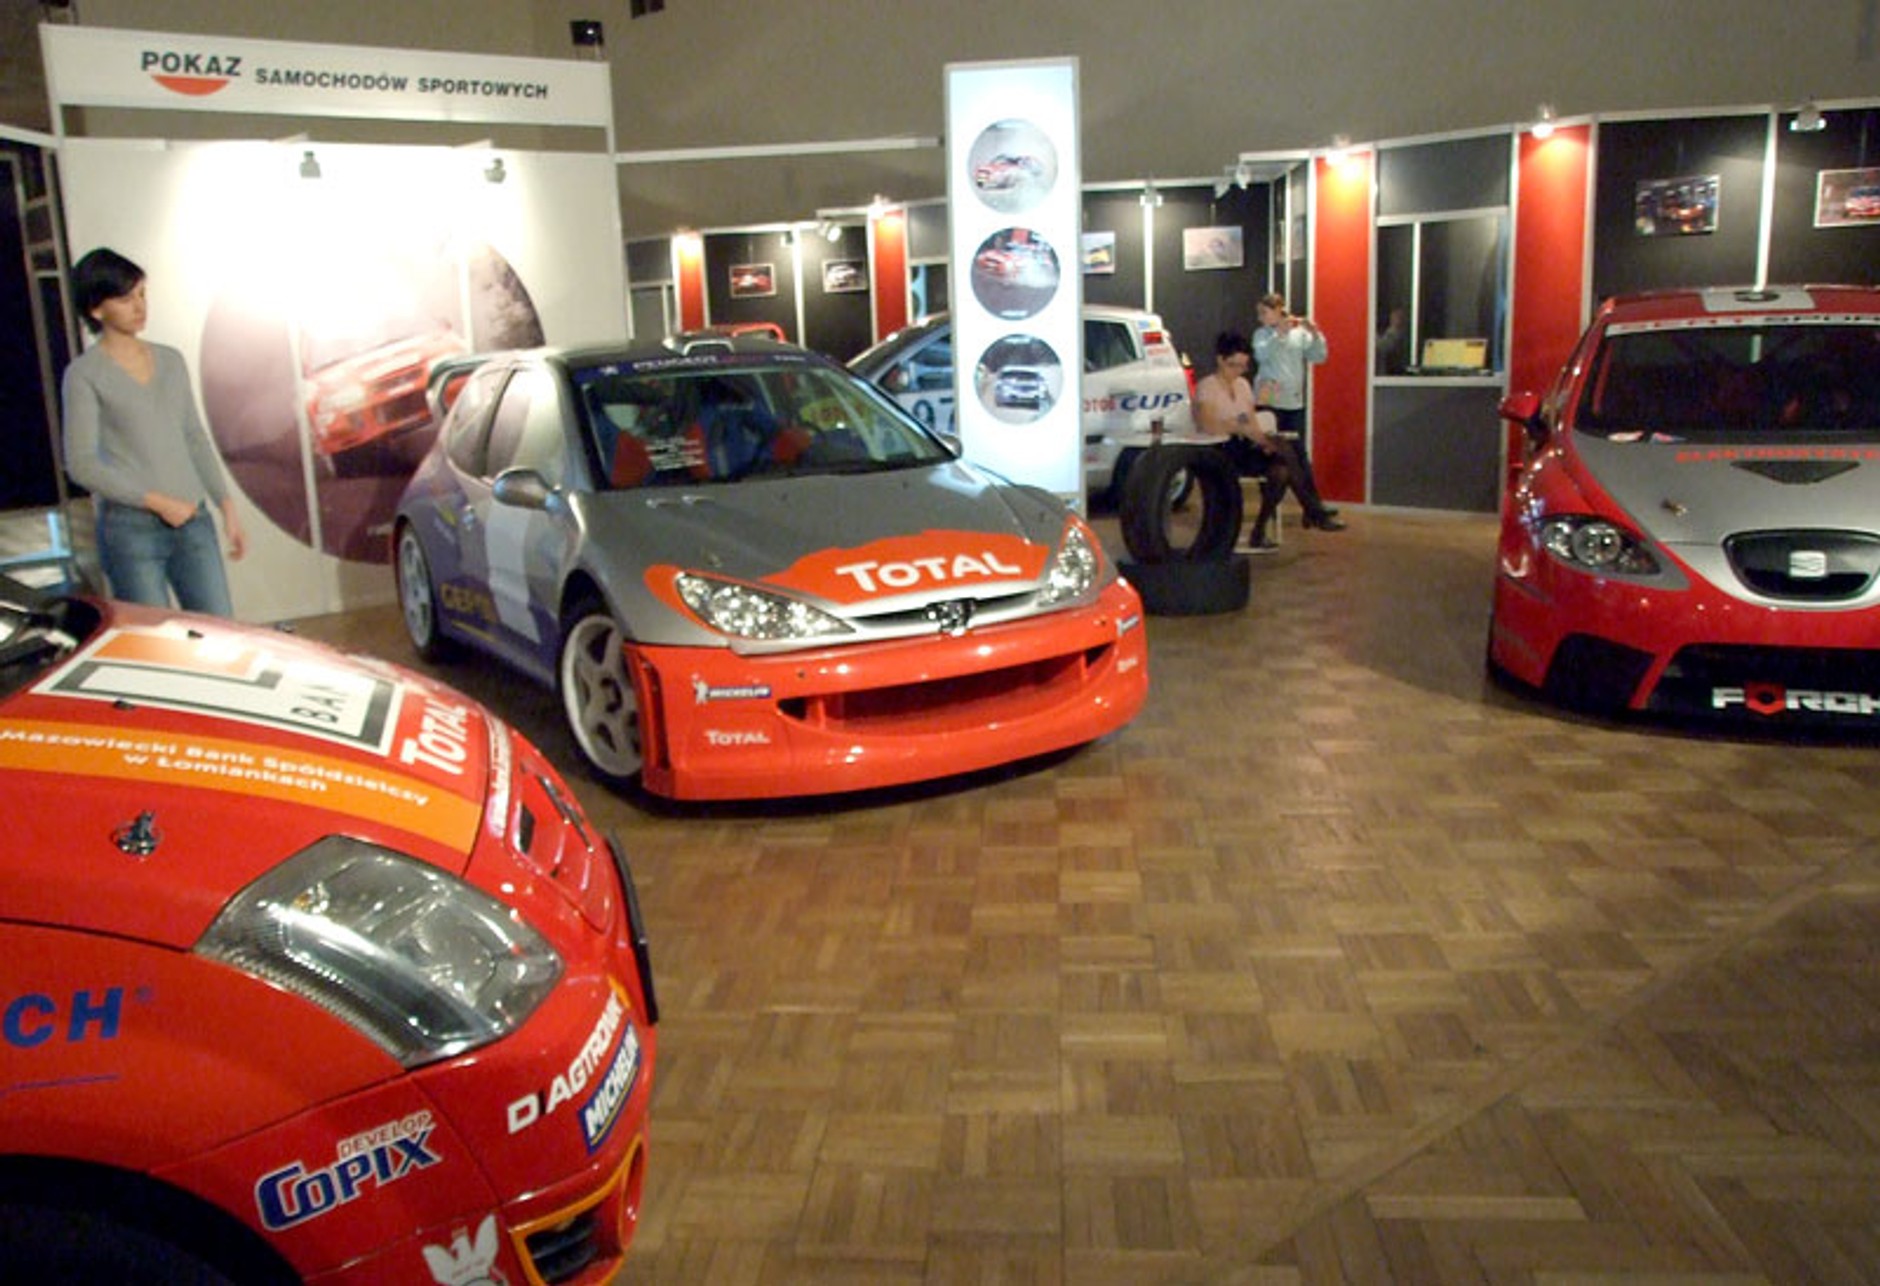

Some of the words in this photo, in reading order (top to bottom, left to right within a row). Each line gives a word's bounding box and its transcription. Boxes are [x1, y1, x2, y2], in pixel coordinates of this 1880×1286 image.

[141, 51, 242, 76] POKAZ
[255, 67, 408, 92] SAMOCHODÓW
[417, 77, 549, 99] SPORTOWYCH
[1119, 392, 1184, 412] CUP
[835, 551, 1022, 592] TOTAL
[0, 729, 178, 755] Mazowiecki
[186, 746, 254, 765] Bank
[400, 698, 468, 775] TOTAL
[704, 730, 771, 745] TOTAL
[585, 1023, 639, 1137] MICHELIN
[338, 1111, 433, 1158] DEVELOP
